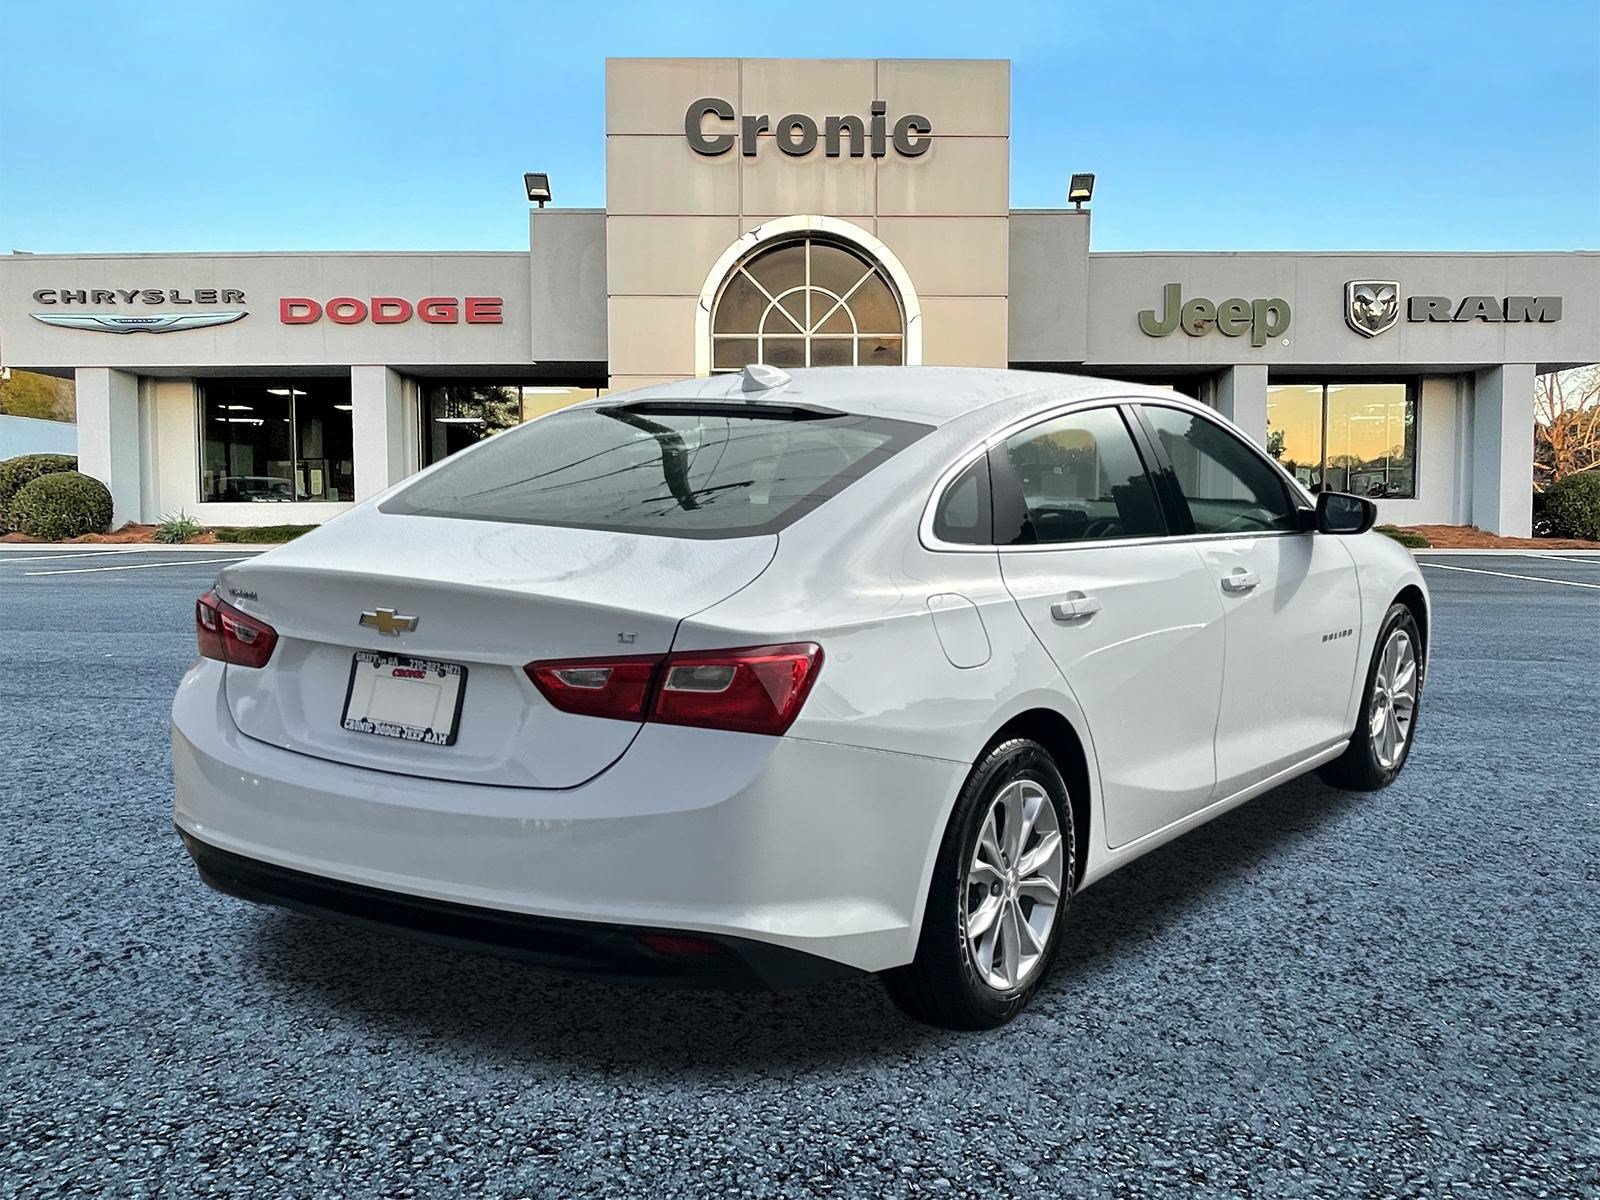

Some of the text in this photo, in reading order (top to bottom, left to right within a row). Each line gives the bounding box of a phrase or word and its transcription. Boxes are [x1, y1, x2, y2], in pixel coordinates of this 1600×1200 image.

[684, 97, 933, 158] Cronic
[32, 288, 248, 305] CHRYSLER
[278, 296, 504, 325] DODGE
[1406, 296, 1563, 323] RAM
[1138, 282, 1292, 347] Jeep
[376, 723, 401, 737] DODGE
[403, 727, 424, 741] JEEP
[425, 731, 448, 745] RAM
